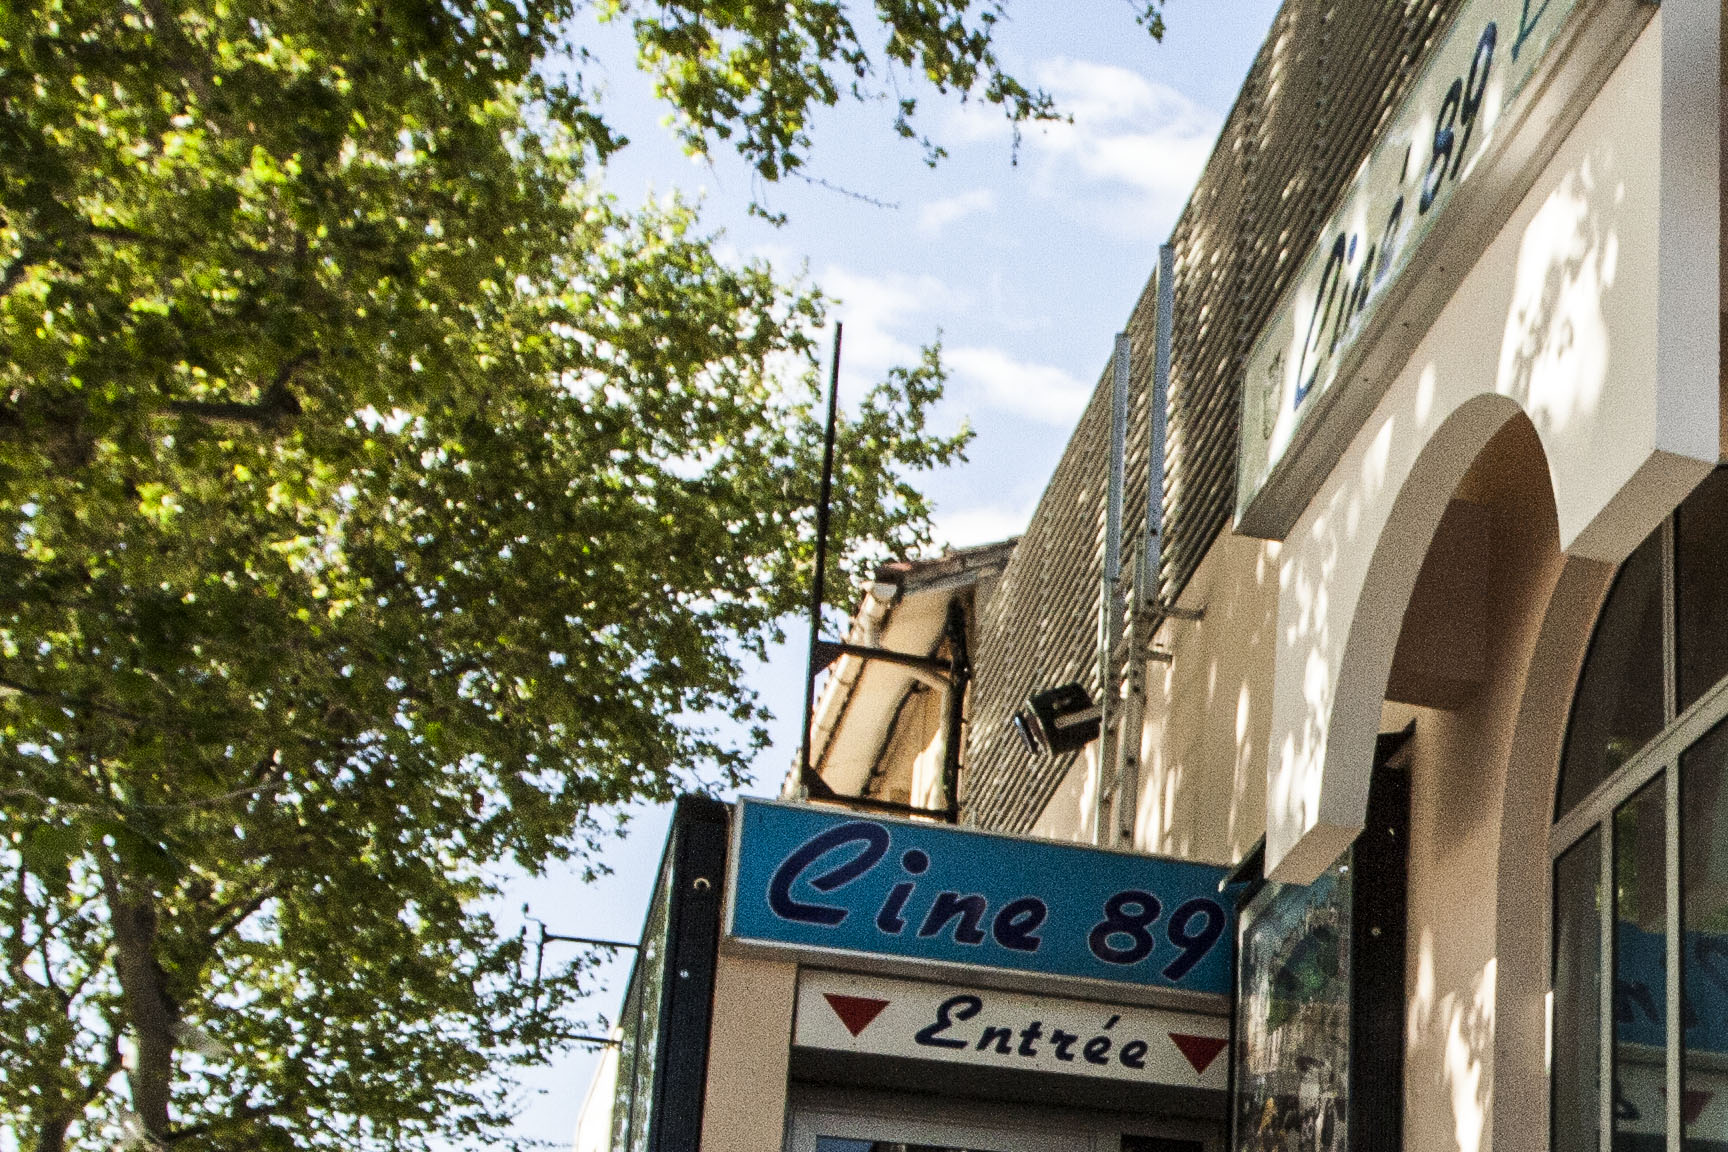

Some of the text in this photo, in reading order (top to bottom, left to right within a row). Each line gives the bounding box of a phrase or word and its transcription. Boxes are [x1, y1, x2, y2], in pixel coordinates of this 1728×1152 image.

[1419, 22, 1497, 216] 89
[768, 820, 1228, 982] Cine 89
[914, 994, 1149, 1070] Entrée
